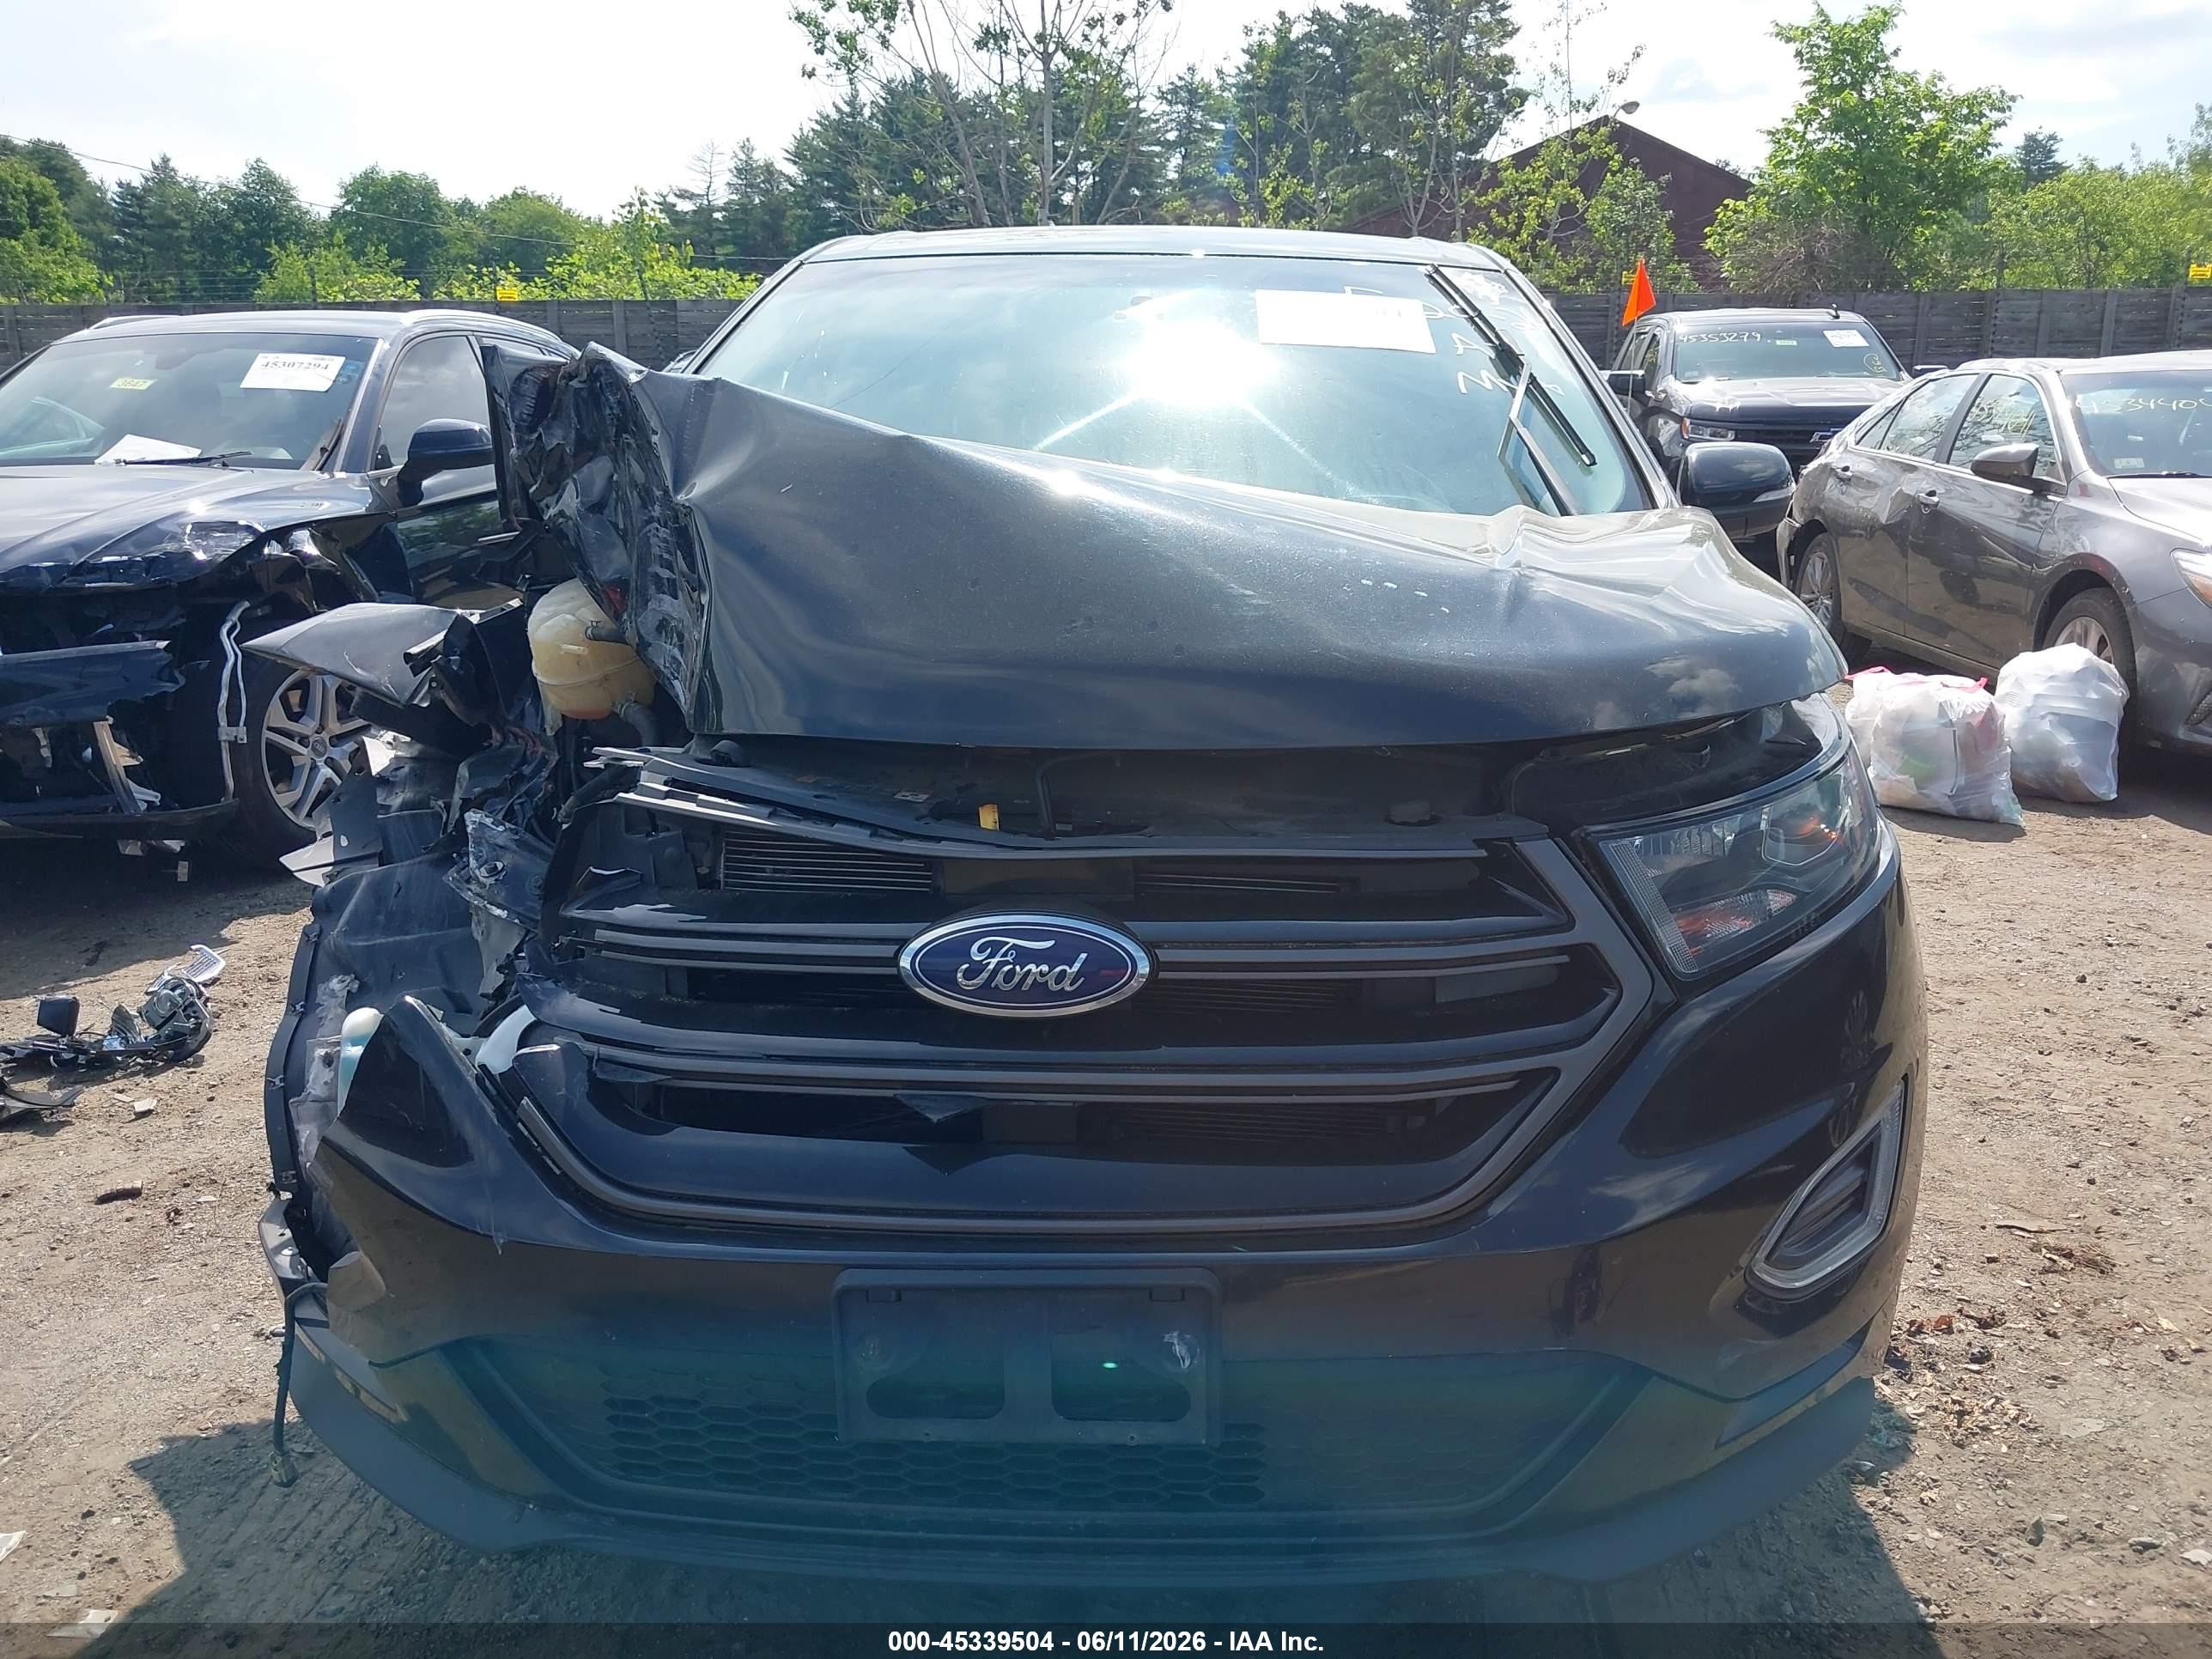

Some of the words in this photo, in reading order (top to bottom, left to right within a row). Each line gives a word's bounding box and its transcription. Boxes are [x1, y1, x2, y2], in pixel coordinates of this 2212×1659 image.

[1678, 331, 1761, 343] 45353279
[261, 360, 331, 371] 45307294
[956, 936, 1085, 991] Ford
